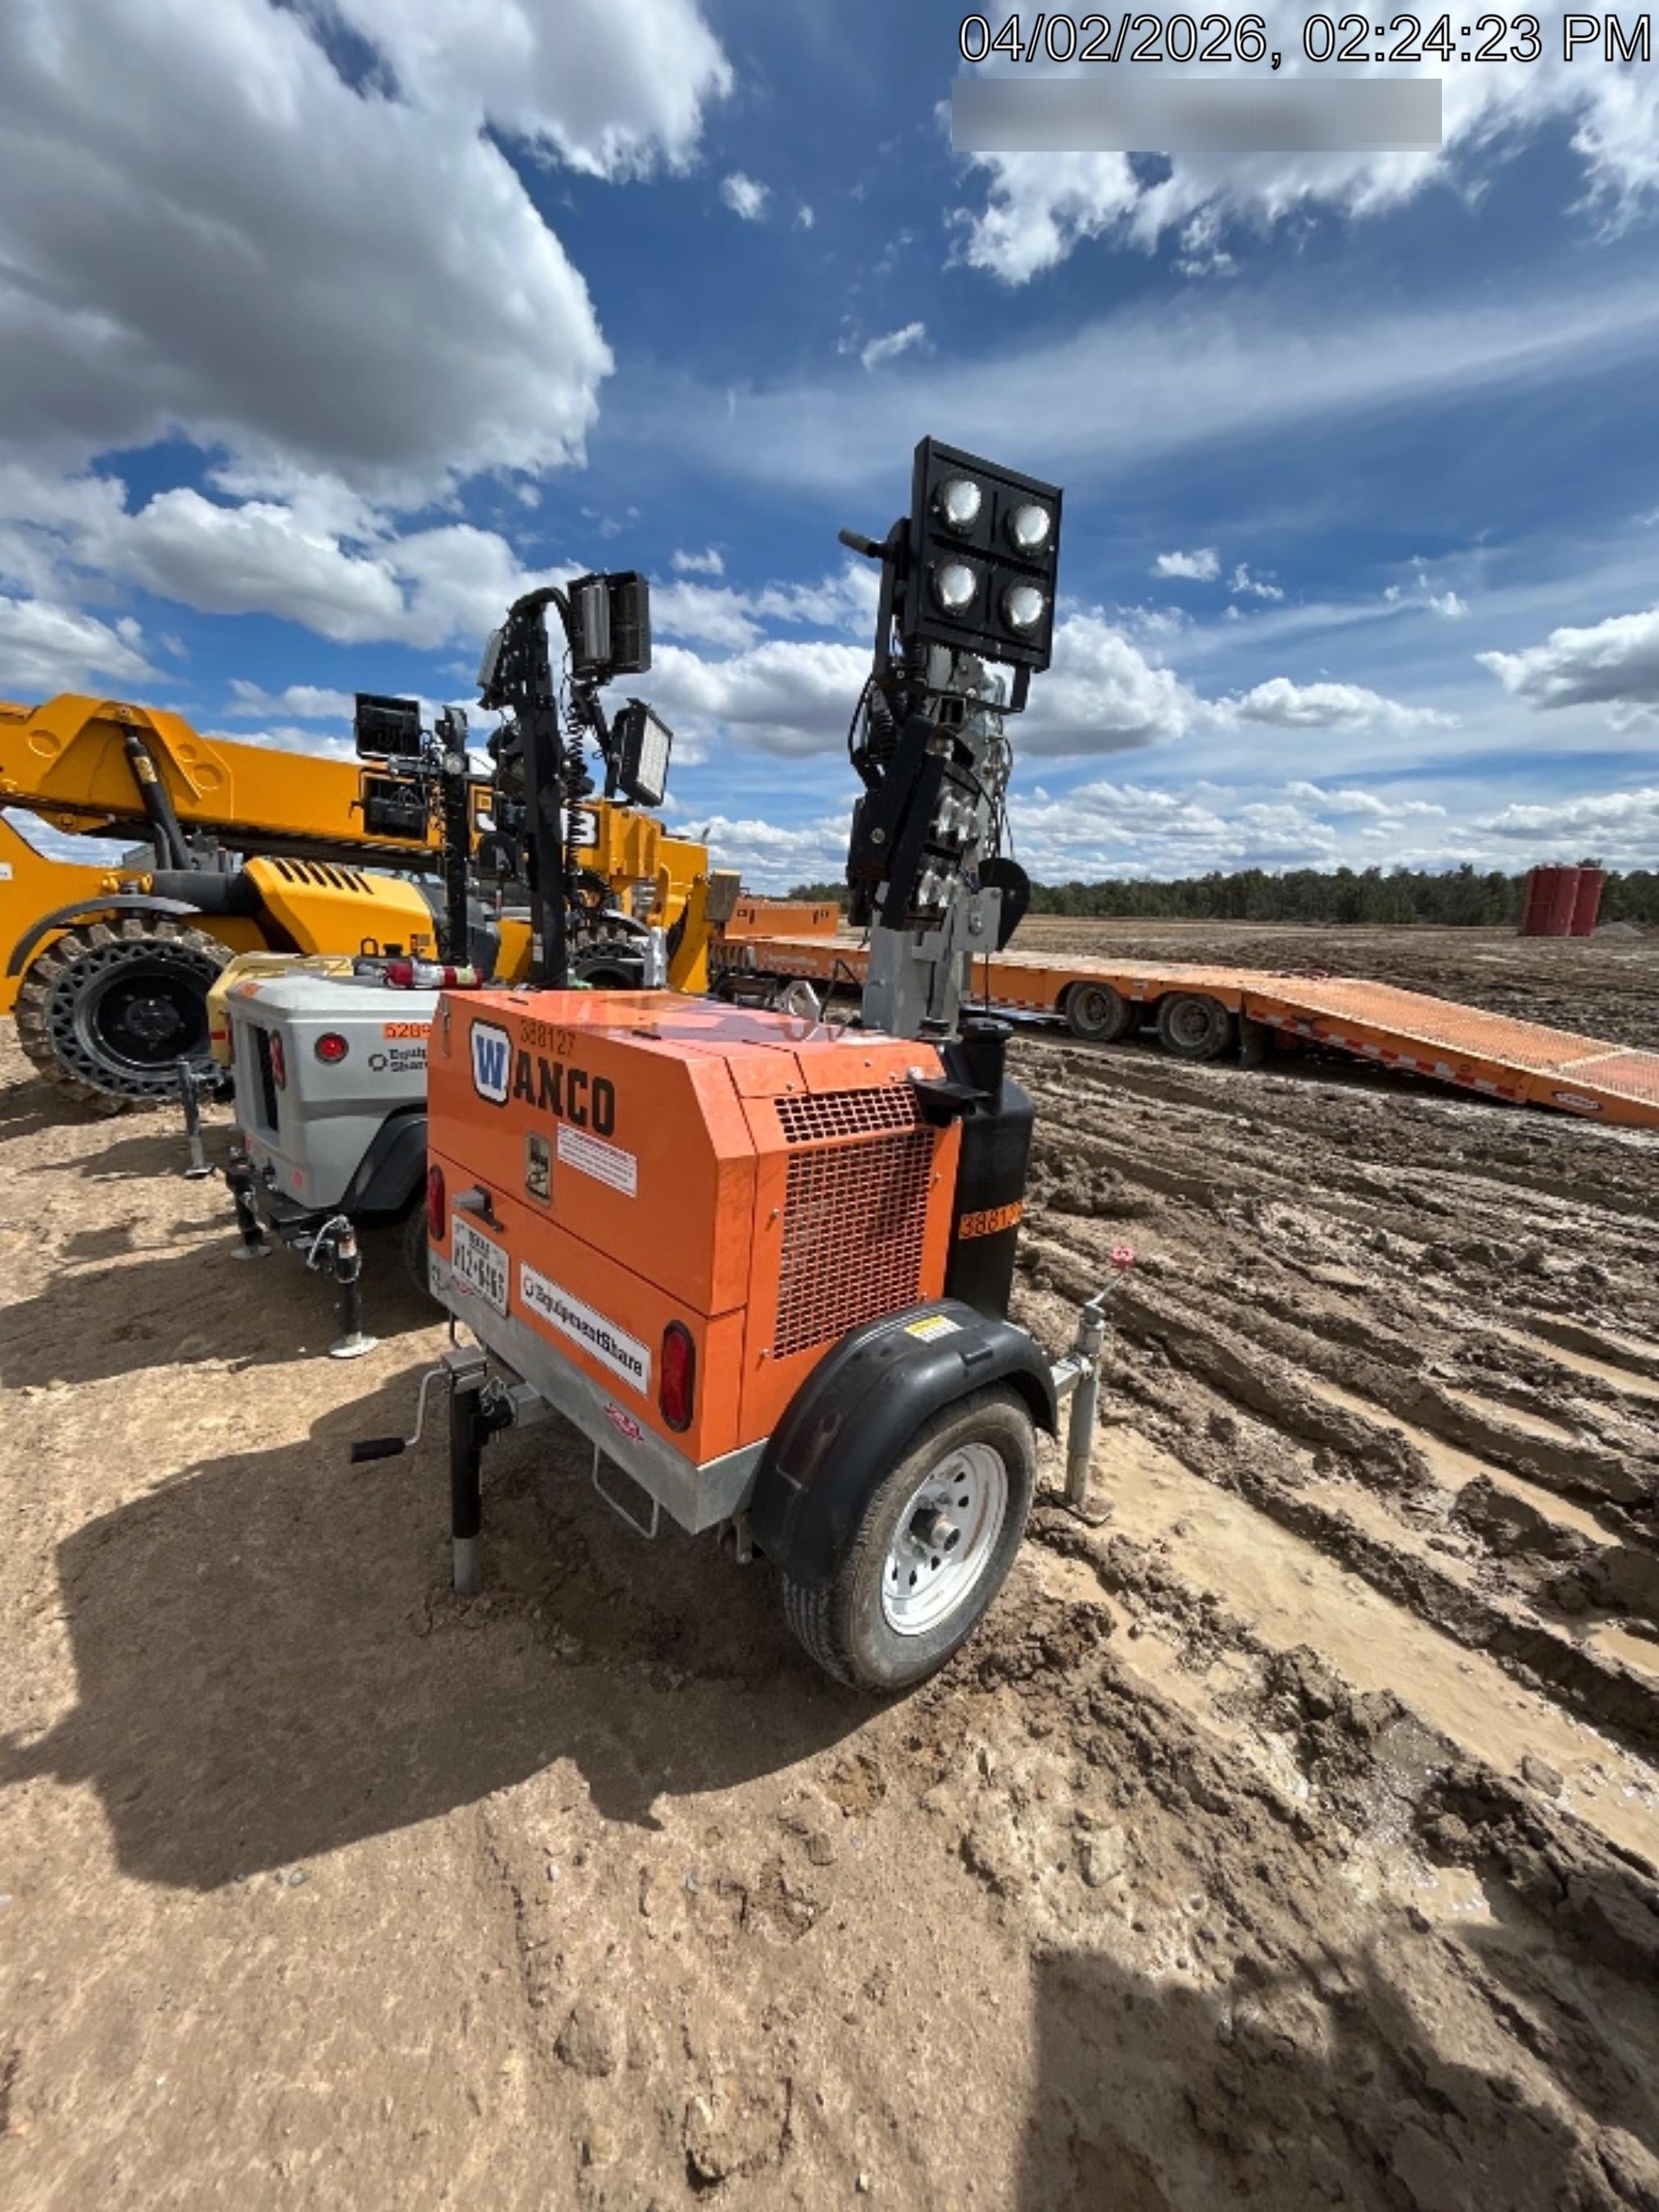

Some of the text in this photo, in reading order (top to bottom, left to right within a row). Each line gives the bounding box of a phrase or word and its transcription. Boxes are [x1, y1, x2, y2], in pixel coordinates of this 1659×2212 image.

[519, 1019, 576, 1057] 388127
[475, 1034, 615, 1137] WANCO
[535, 1283, 643, 1377] EquipmentShare
